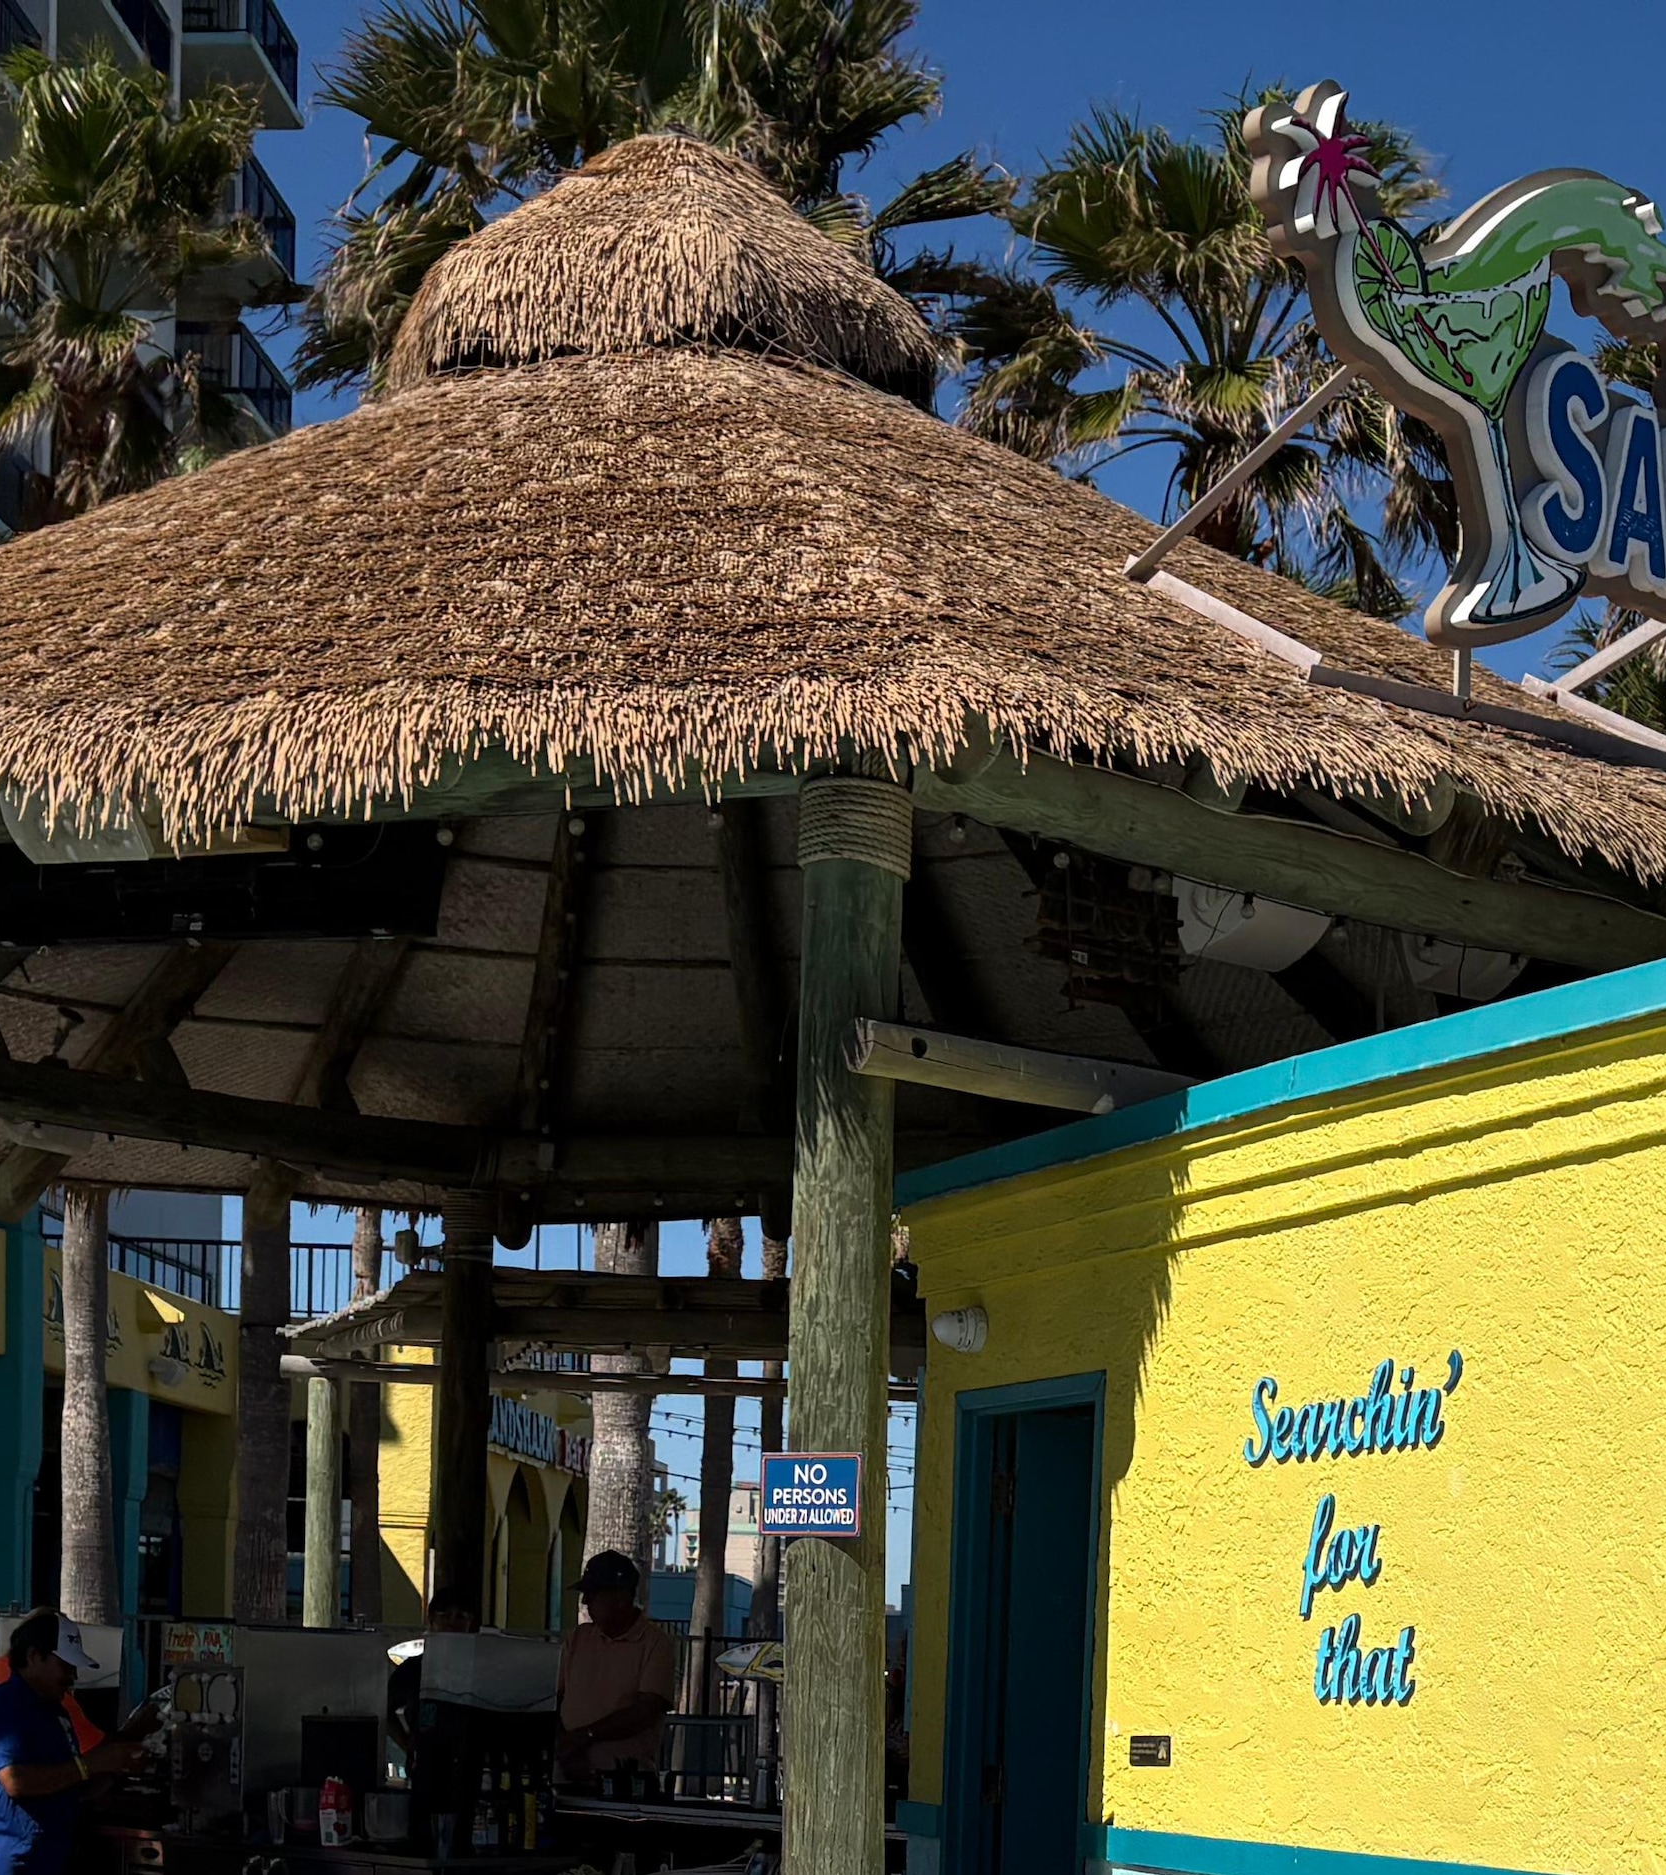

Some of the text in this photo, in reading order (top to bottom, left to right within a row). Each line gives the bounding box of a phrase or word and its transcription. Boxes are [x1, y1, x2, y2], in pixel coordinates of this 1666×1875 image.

[489, 1393, 555, 1466] ANDSHARK
[1243, 1350, 1463, 1467] Searchin'
[773, 1488, 847, 1505] PERSONS
[794, 1463, 827, 1485] NO
[764, 1508, 855, 1525] UNDER 21 ALLOWED
[1299, 1494, 1381, 1619] for
[1313, 1613, 1415, 1705] that
